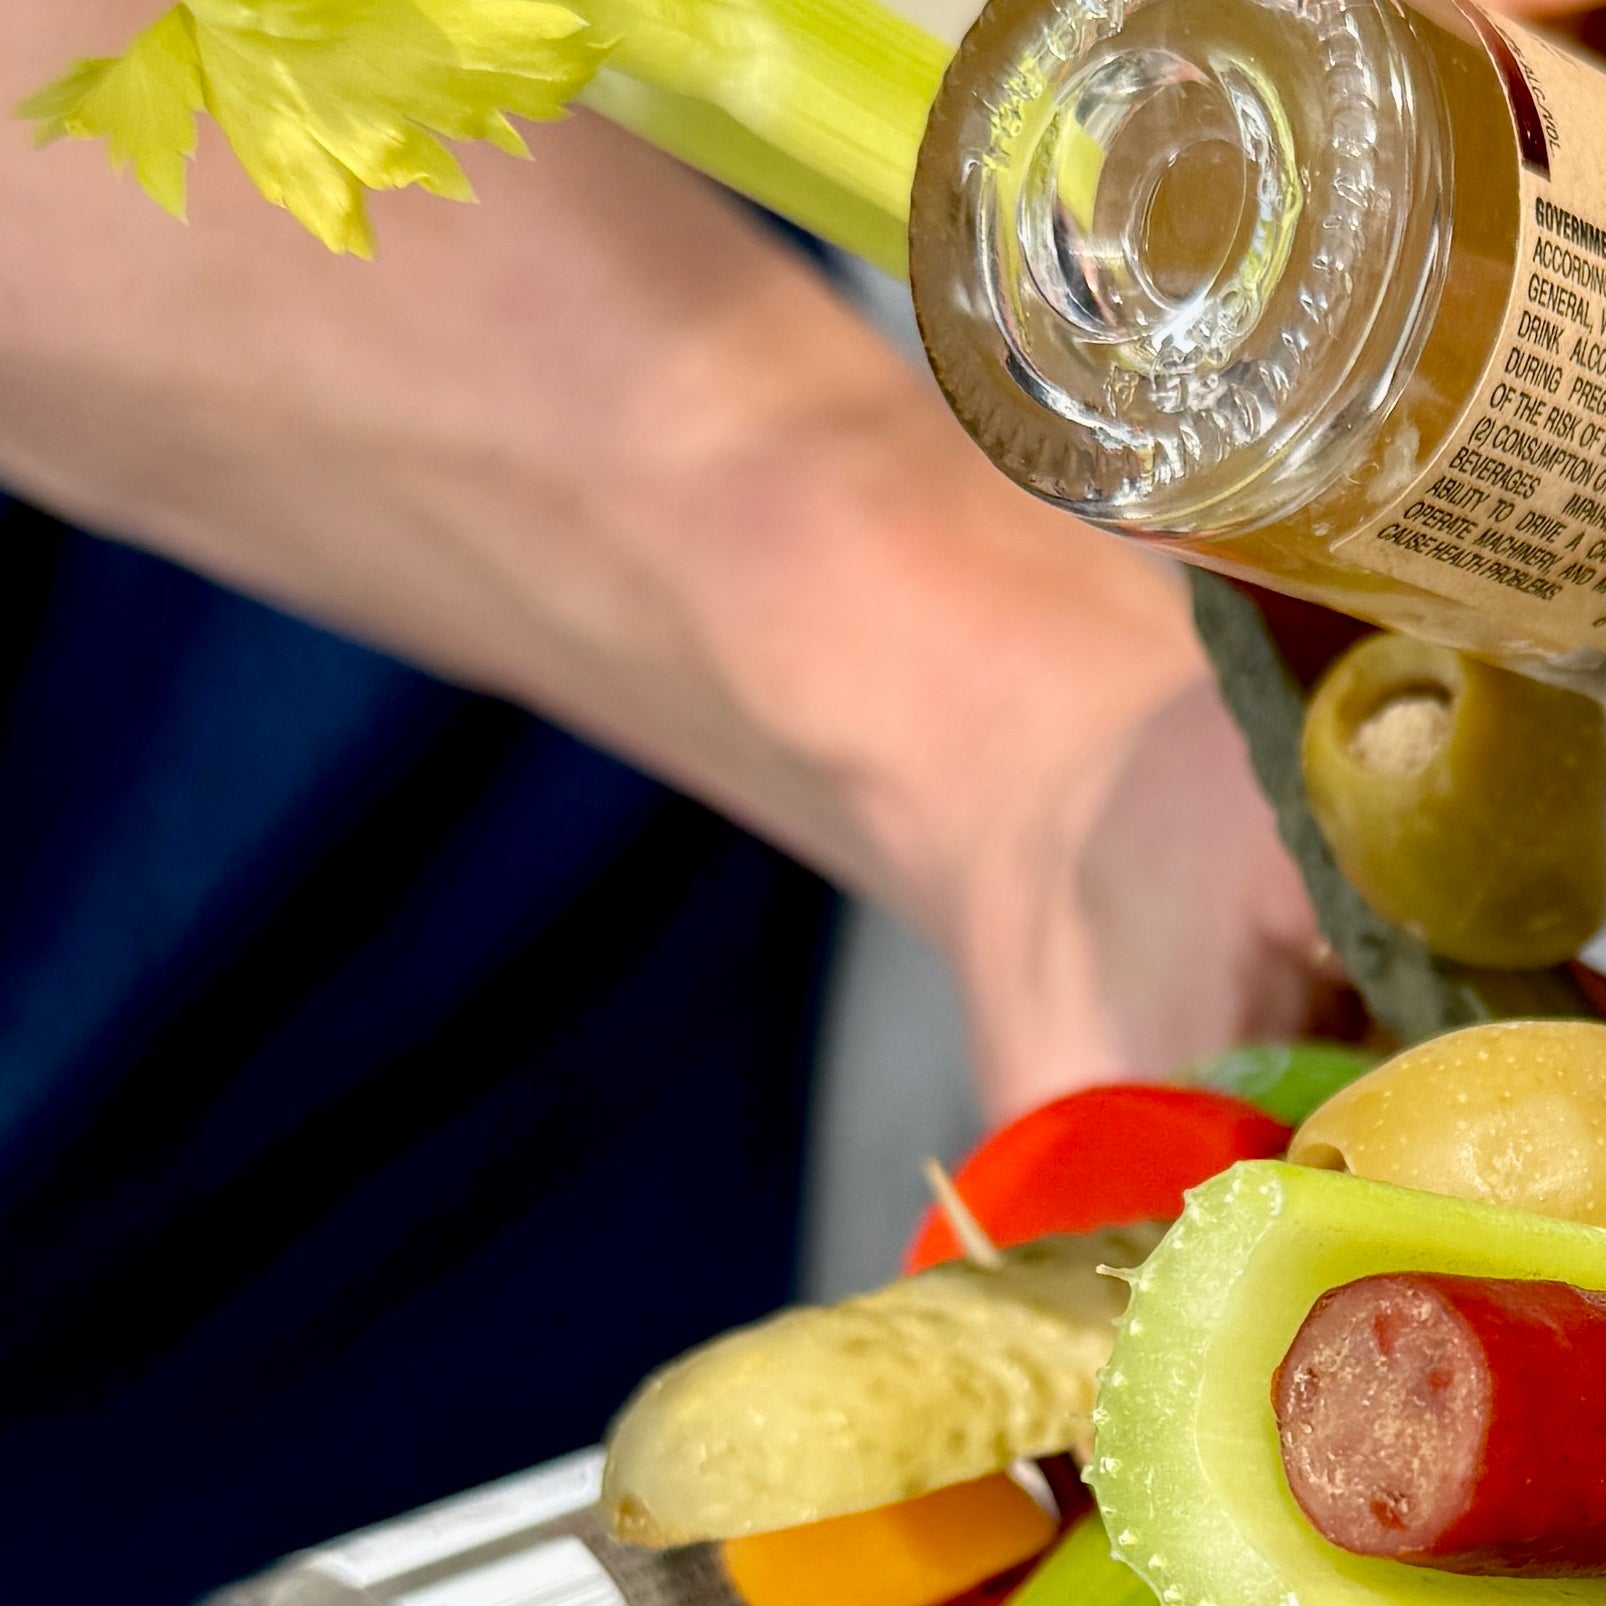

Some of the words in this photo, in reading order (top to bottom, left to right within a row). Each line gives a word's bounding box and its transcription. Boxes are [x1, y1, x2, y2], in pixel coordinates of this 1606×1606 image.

[1517, 310, 1565, 355] DRINK
[1528, 273, 1594, 335] GENERAL,
[1504, 346, 1563, 395] DURING
[1489, 383, 1517, 412] OF
[1513, 391, 1547, 428] THE
[1543, 406, 1583, 443] RISK
[1579, 422, 1606, 451] OF
[1449, 446, 1541, 500] BEVERAGES
[1468, 415, 1496, 449] (2)
[1492, 424, 1600, 488] CONSUMPTION
[1403, 501, 1479, 540] OPERATE
[1473, 528, 1564, 575] MACHINERY,
[1559, 562, 1597, 586] AND
[1426, 475, 1491, 513] ABILITY
[1487, 499, 1516, 523] TO
[1515, 510, 1568, 544] DRIVE
[1564, 531, 1586, 553] A
[1376, 523, 1438, 554] CAUSE
[1429, 541, 1490, 577] HEALTH
